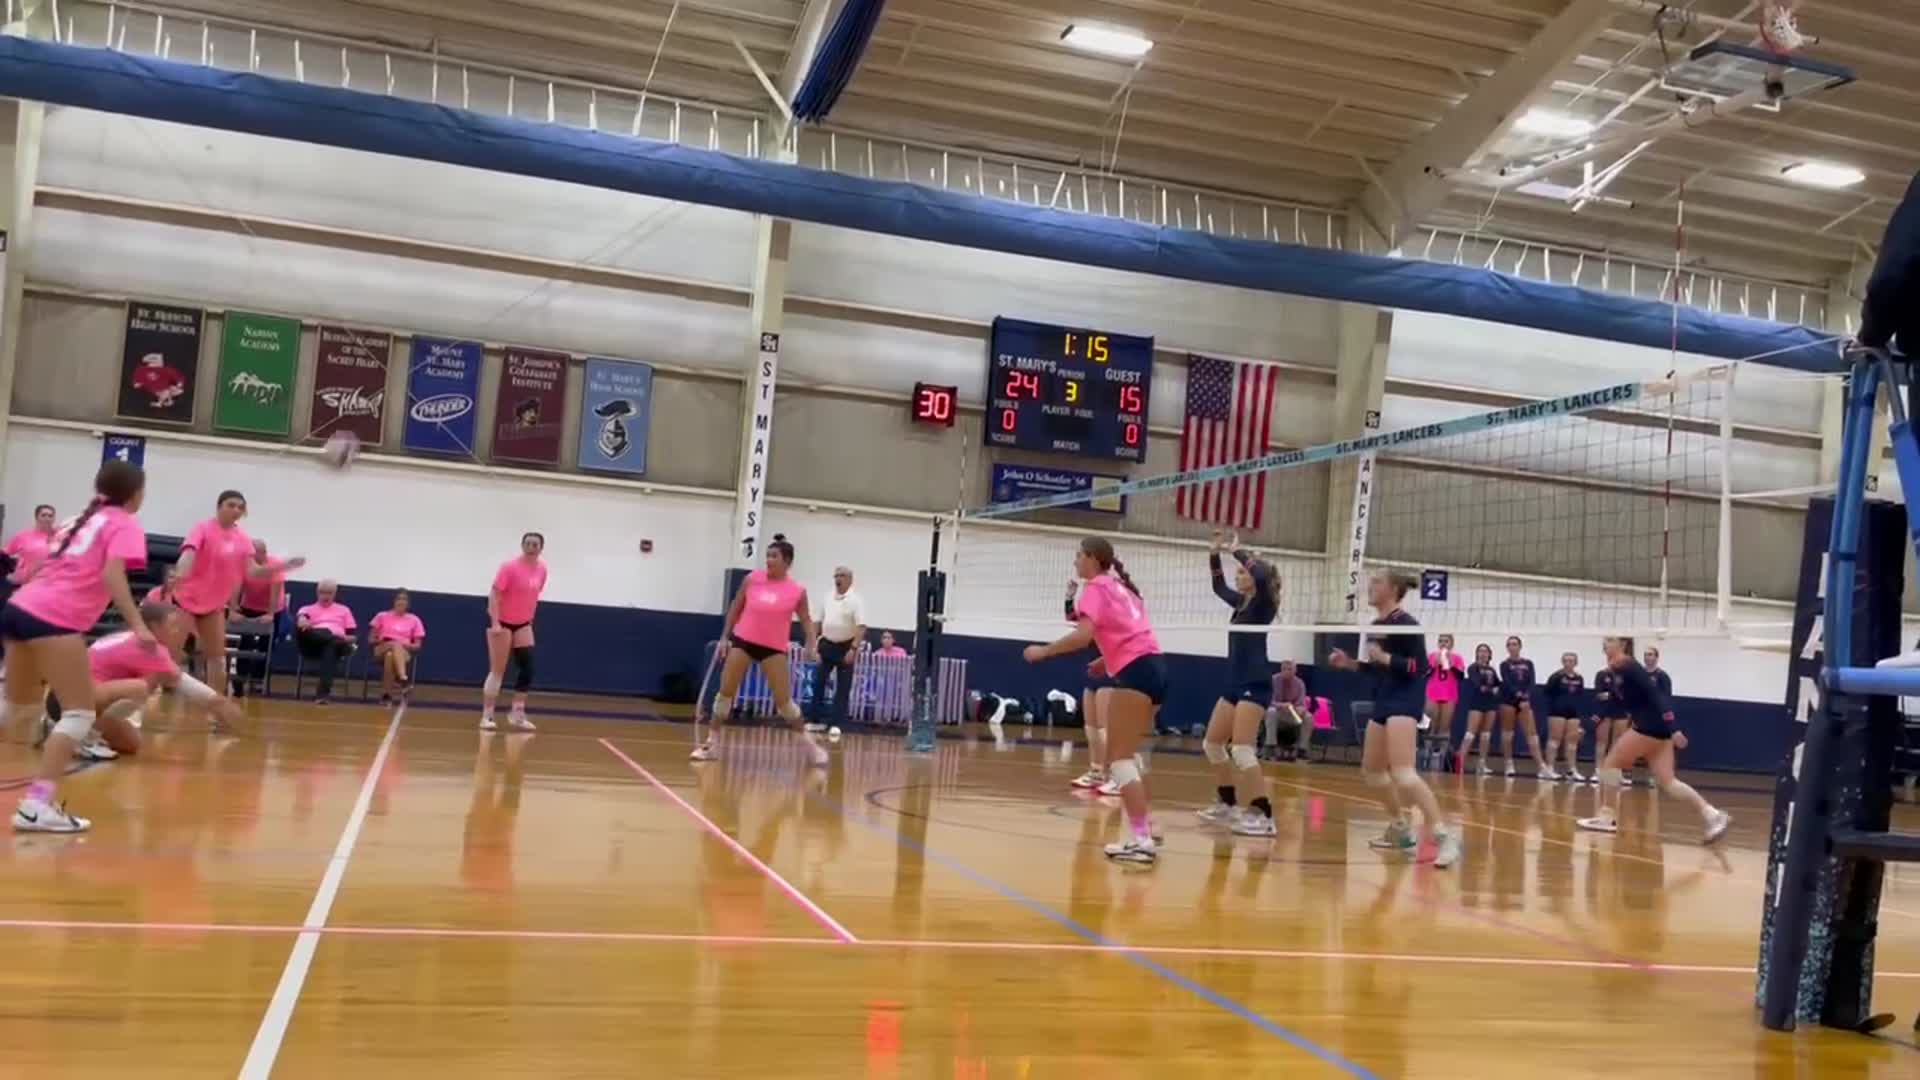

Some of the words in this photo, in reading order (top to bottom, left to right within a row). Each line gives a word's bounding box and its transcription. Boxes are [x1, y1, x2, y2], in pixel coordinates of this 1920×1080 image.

[1064, 333, 1109, 362] 1:15
[1006, 371, 1039, 399] 24
[1105, 367, 1141, 383] GUEST
[1065, 381, 1078, 402] 3
[1119, 387, 1141, 412] 15
[1508, 400, 1558, 421] MARY'S
[1563, 383, 1633, 410] LANCERS
[919, 390, 950, 420] 30
[1002, 410, 1015, 430] 0
[1125, 424, 1138, 444] 0
[1352, 434, 1390, 452] MARY'S
[1392, 423, 1443, 444] LANCERS
[115, 446, 129, 462] 1
[1426, 580, 1441, 598] 2
